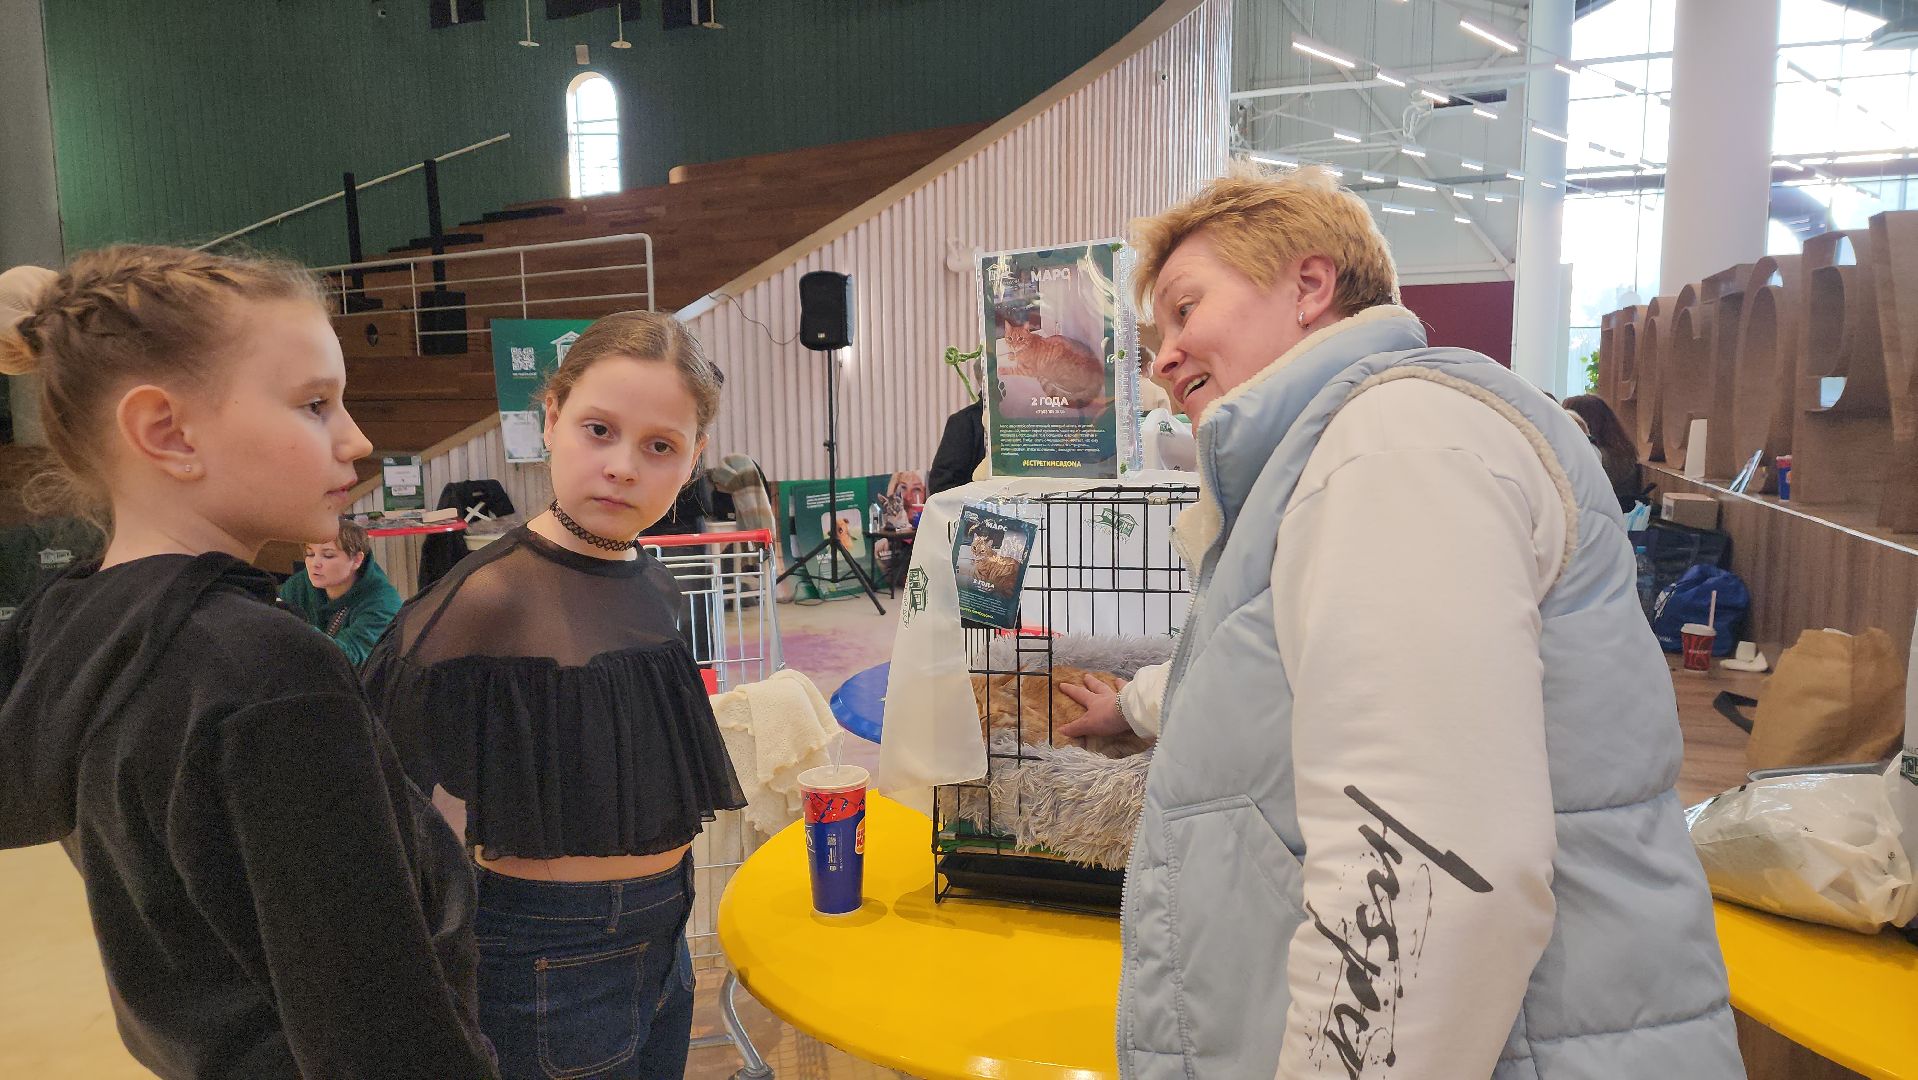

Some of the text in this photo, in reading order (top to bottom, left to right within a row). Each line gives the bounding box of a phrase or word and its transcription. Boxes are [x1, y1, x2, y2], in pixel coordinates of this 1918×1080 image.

[1031, 396, 1070, 407] 2 ГОДА
[985, 520, 1008, 532] МАРС
